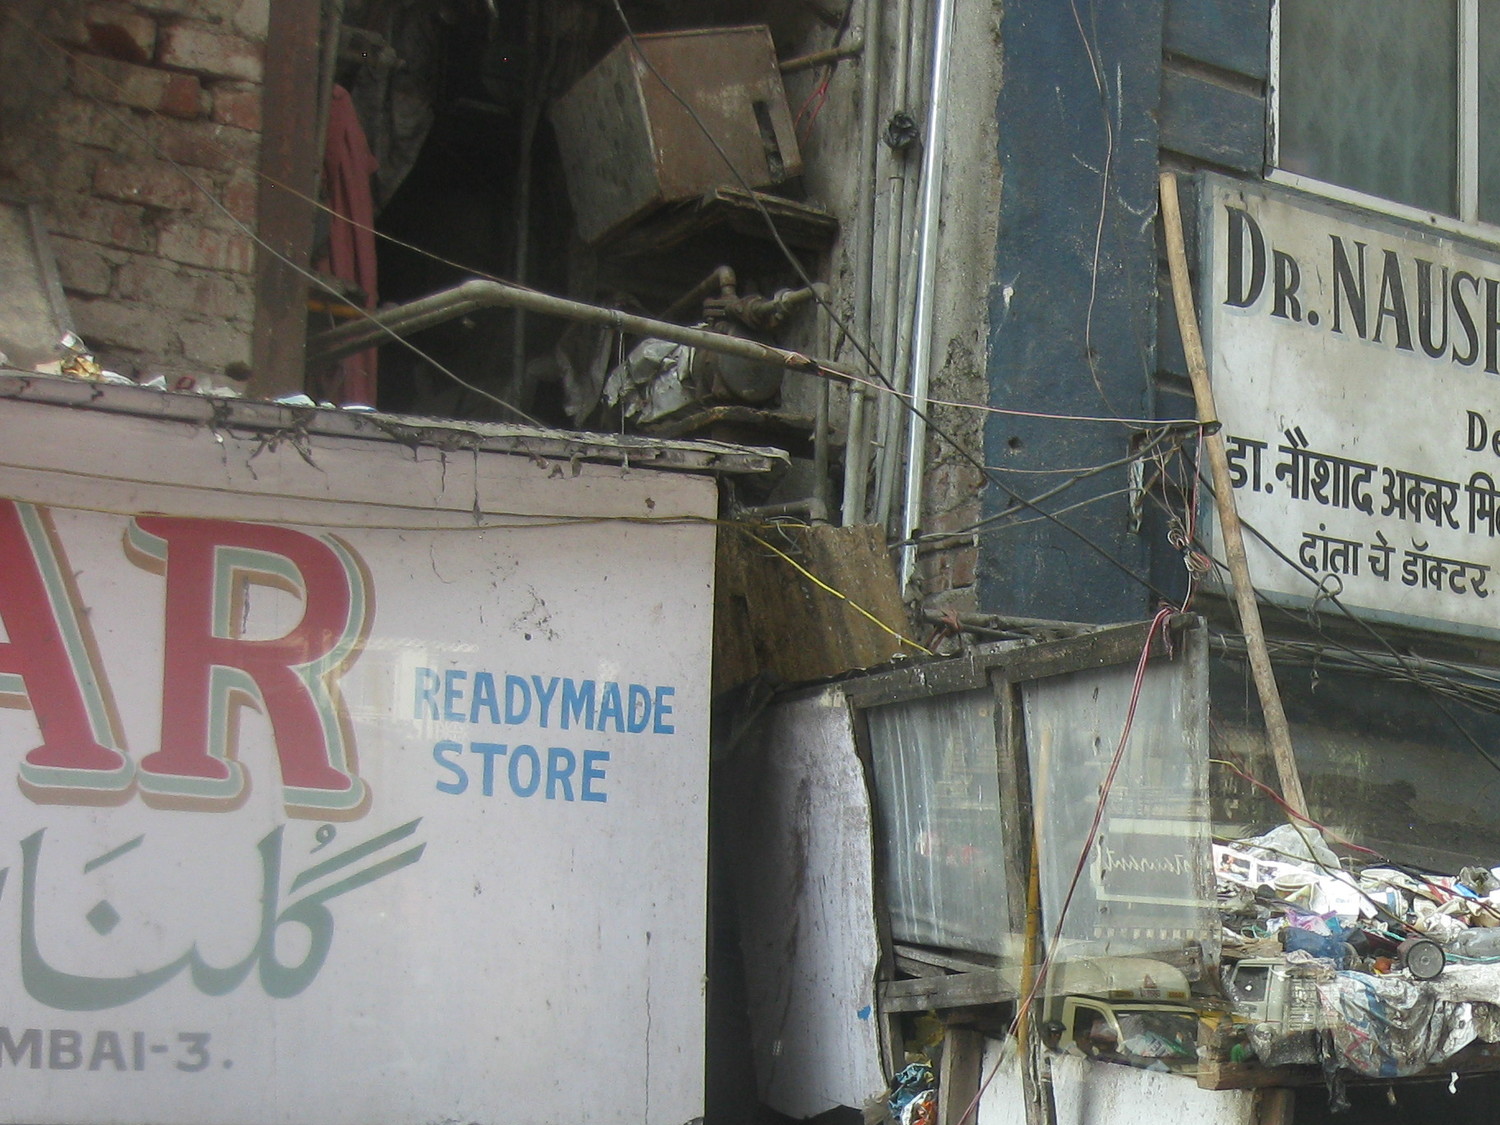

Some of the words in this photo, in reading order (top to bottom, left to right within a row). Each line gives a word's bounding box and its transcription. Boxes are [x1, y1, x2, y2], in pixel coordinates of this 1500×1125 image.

[1368, 530, 1396, 581] चे
[414, 667, 676, 735] READYMADE
[433, 739, 610, 803] STORE
